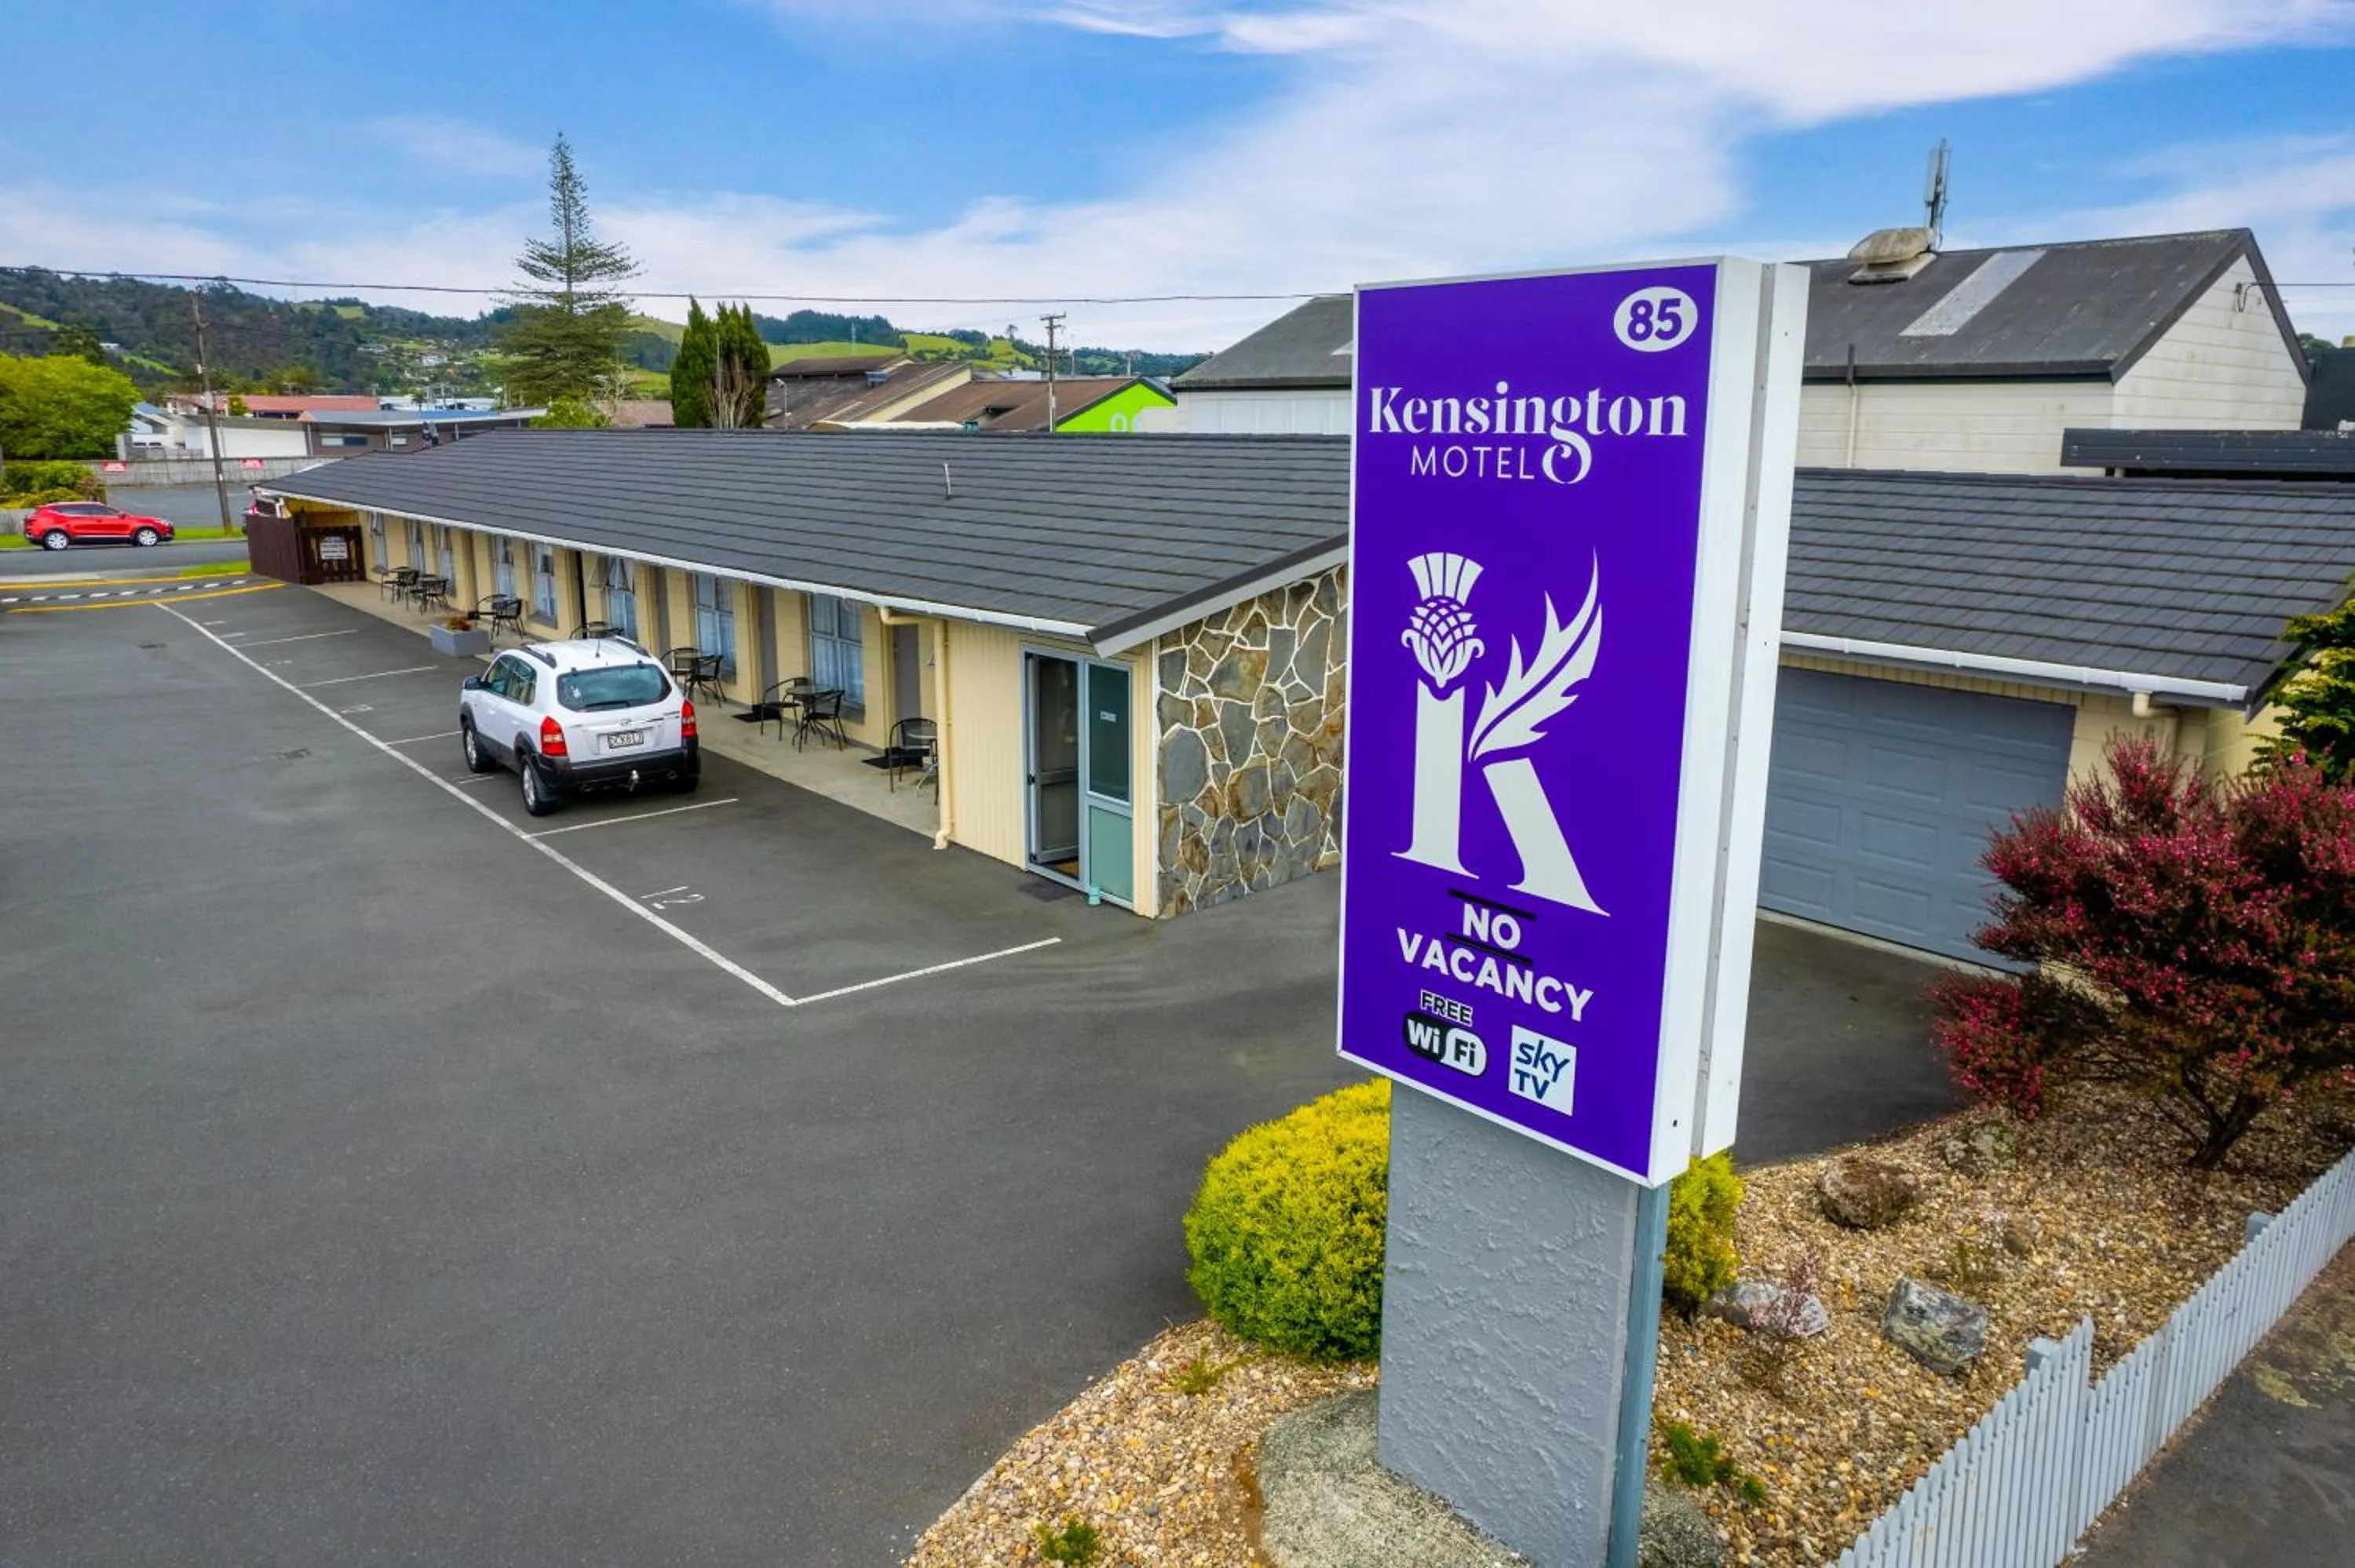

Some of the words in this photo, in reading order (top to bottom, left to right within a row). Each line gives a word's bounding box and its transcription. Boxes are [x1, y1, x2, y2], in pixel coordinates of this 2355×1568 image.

[1627, 298, 1682, 342] 85
[1368, 381, 1689, 484] Kensington
[1411, 446, 1535, 480] MOTEL
[1462, 903, 1521, 950] NO
[1397, 927, 1594, 1022] VACANCY
[1420, 990, 1473, 1026] FREE
[1513, 1069, 1550, 1099] TV
